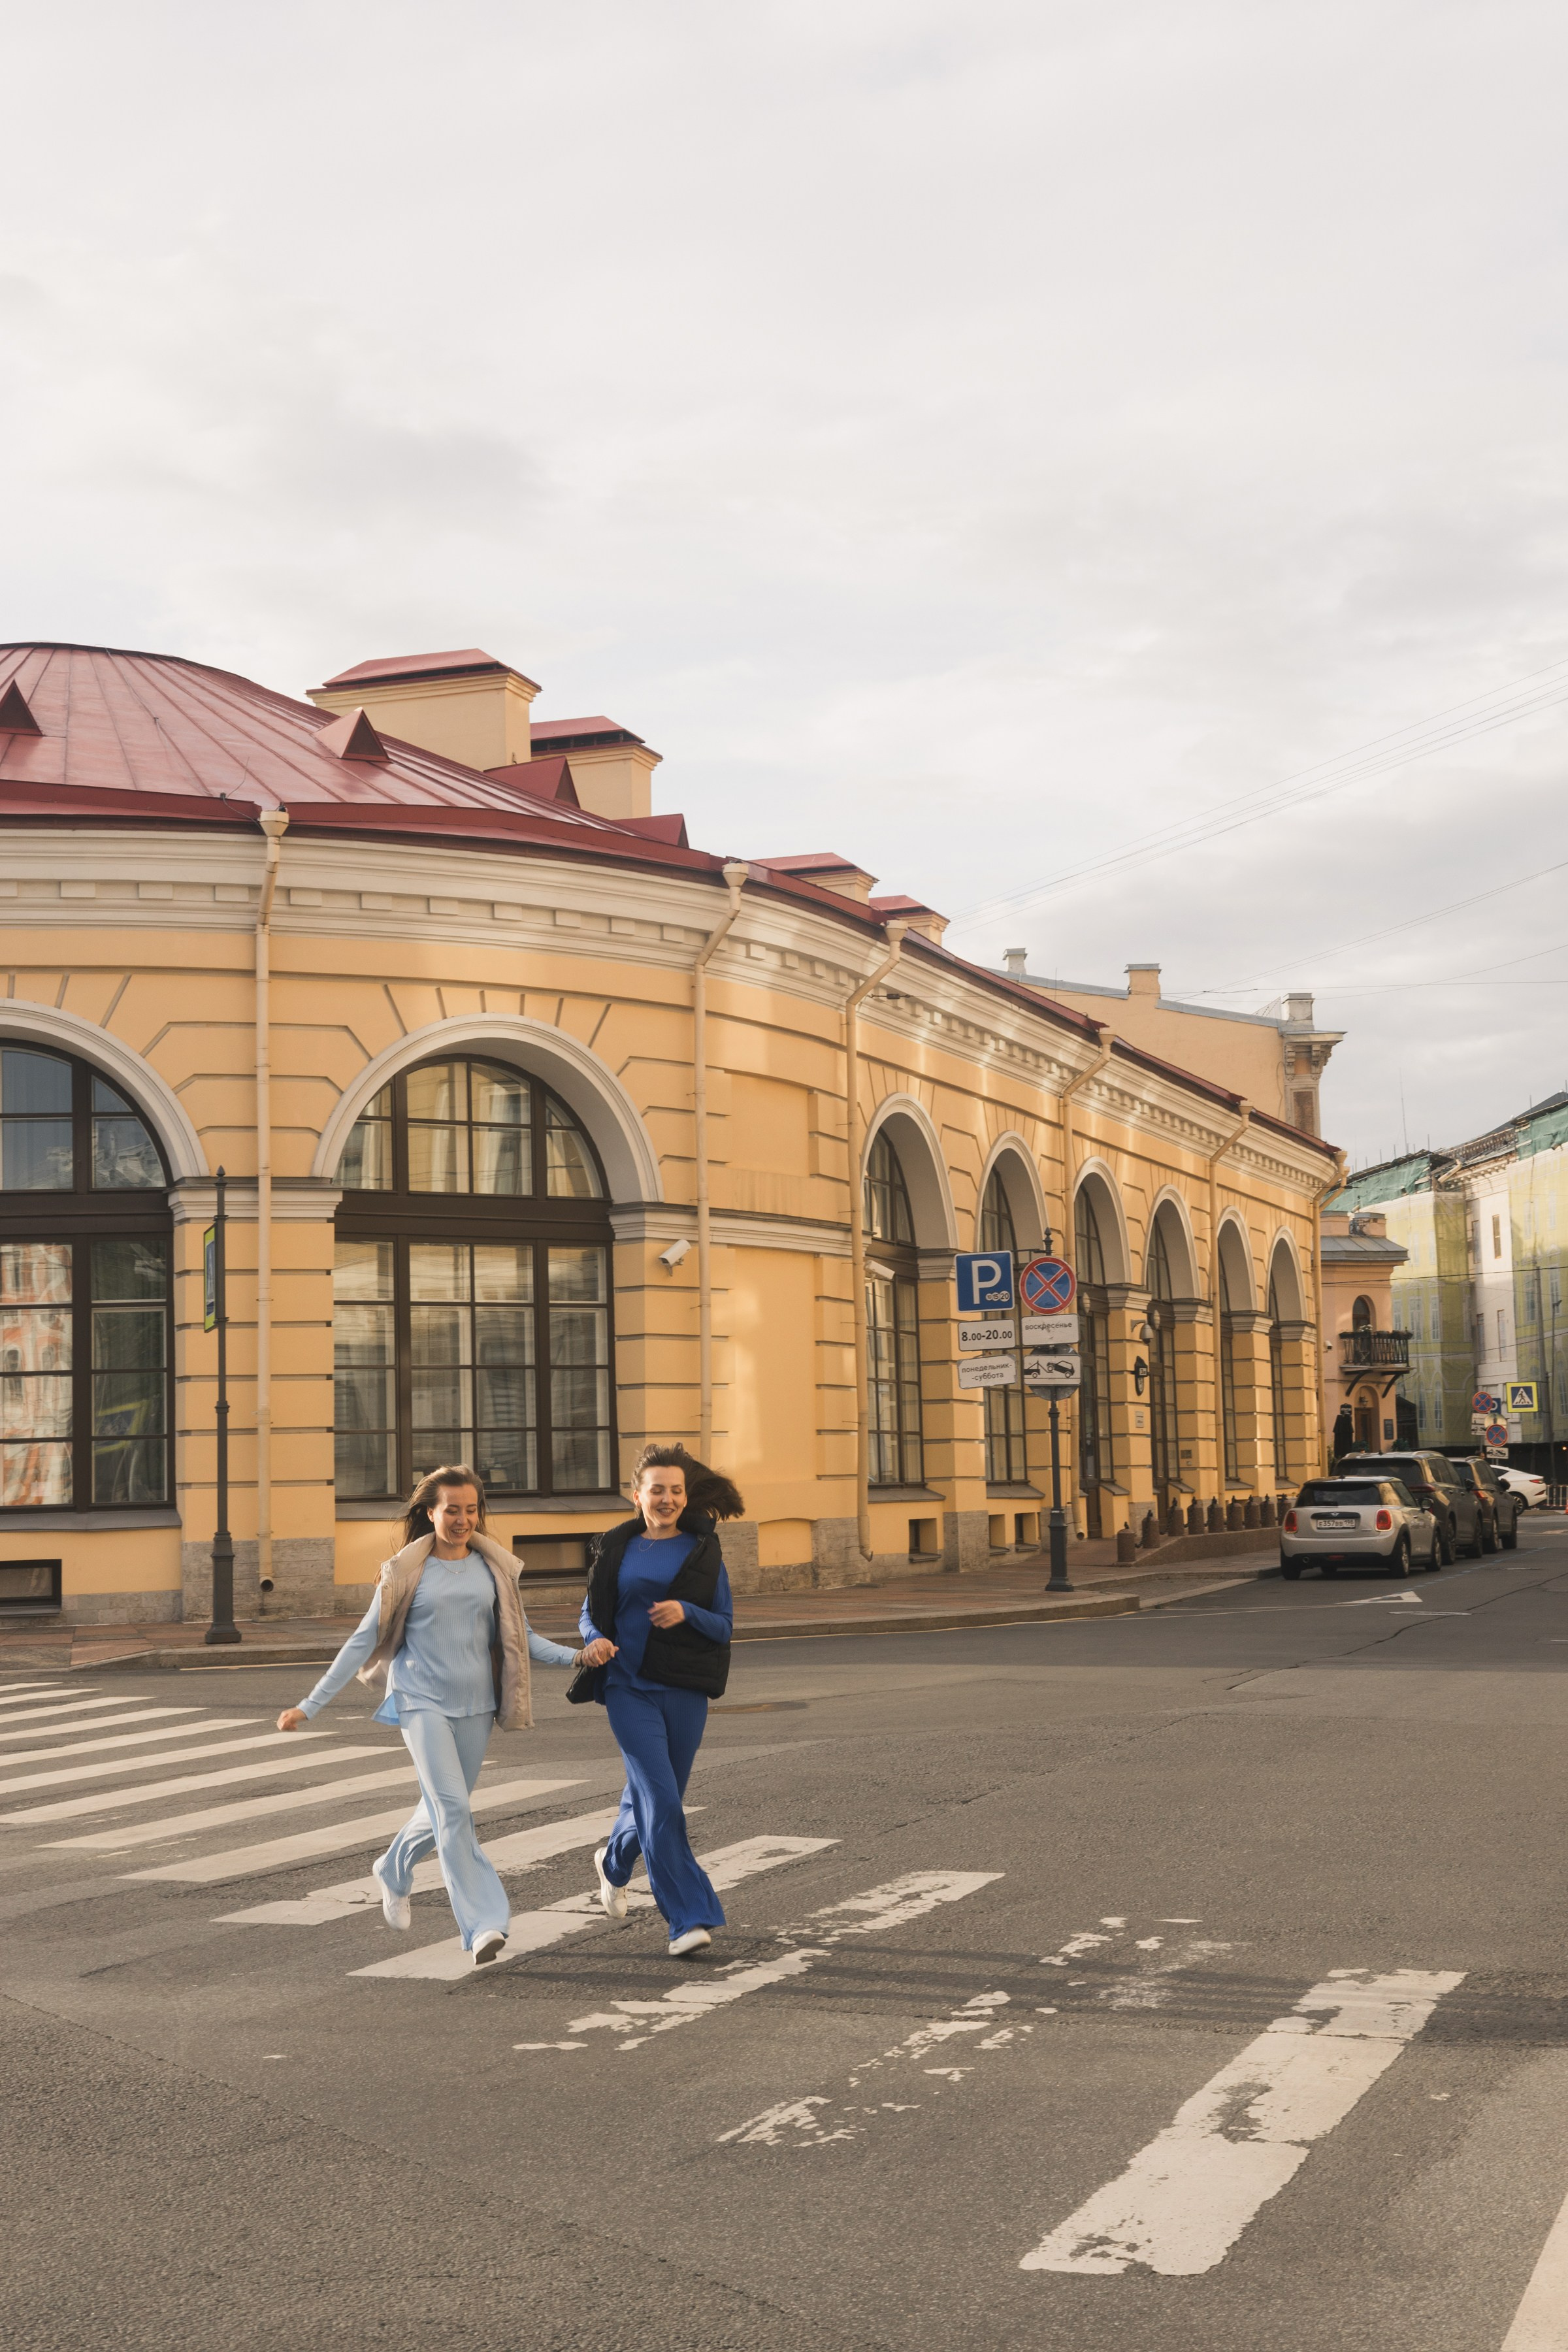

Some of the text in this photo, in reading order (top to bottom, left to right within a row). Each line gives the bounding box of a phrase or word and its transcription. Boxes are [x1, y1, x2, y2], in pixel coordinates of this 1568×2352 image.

[971, 1260, 1002, 1304] P
[1025, 1322, 1072, 1331] воскресенье
[962, 1330, 1013, 1341] 8.00-20.00
[962, 1363, 1013, 1373] понедельник-
[972, 1372, 1004, 1382] -суббота
